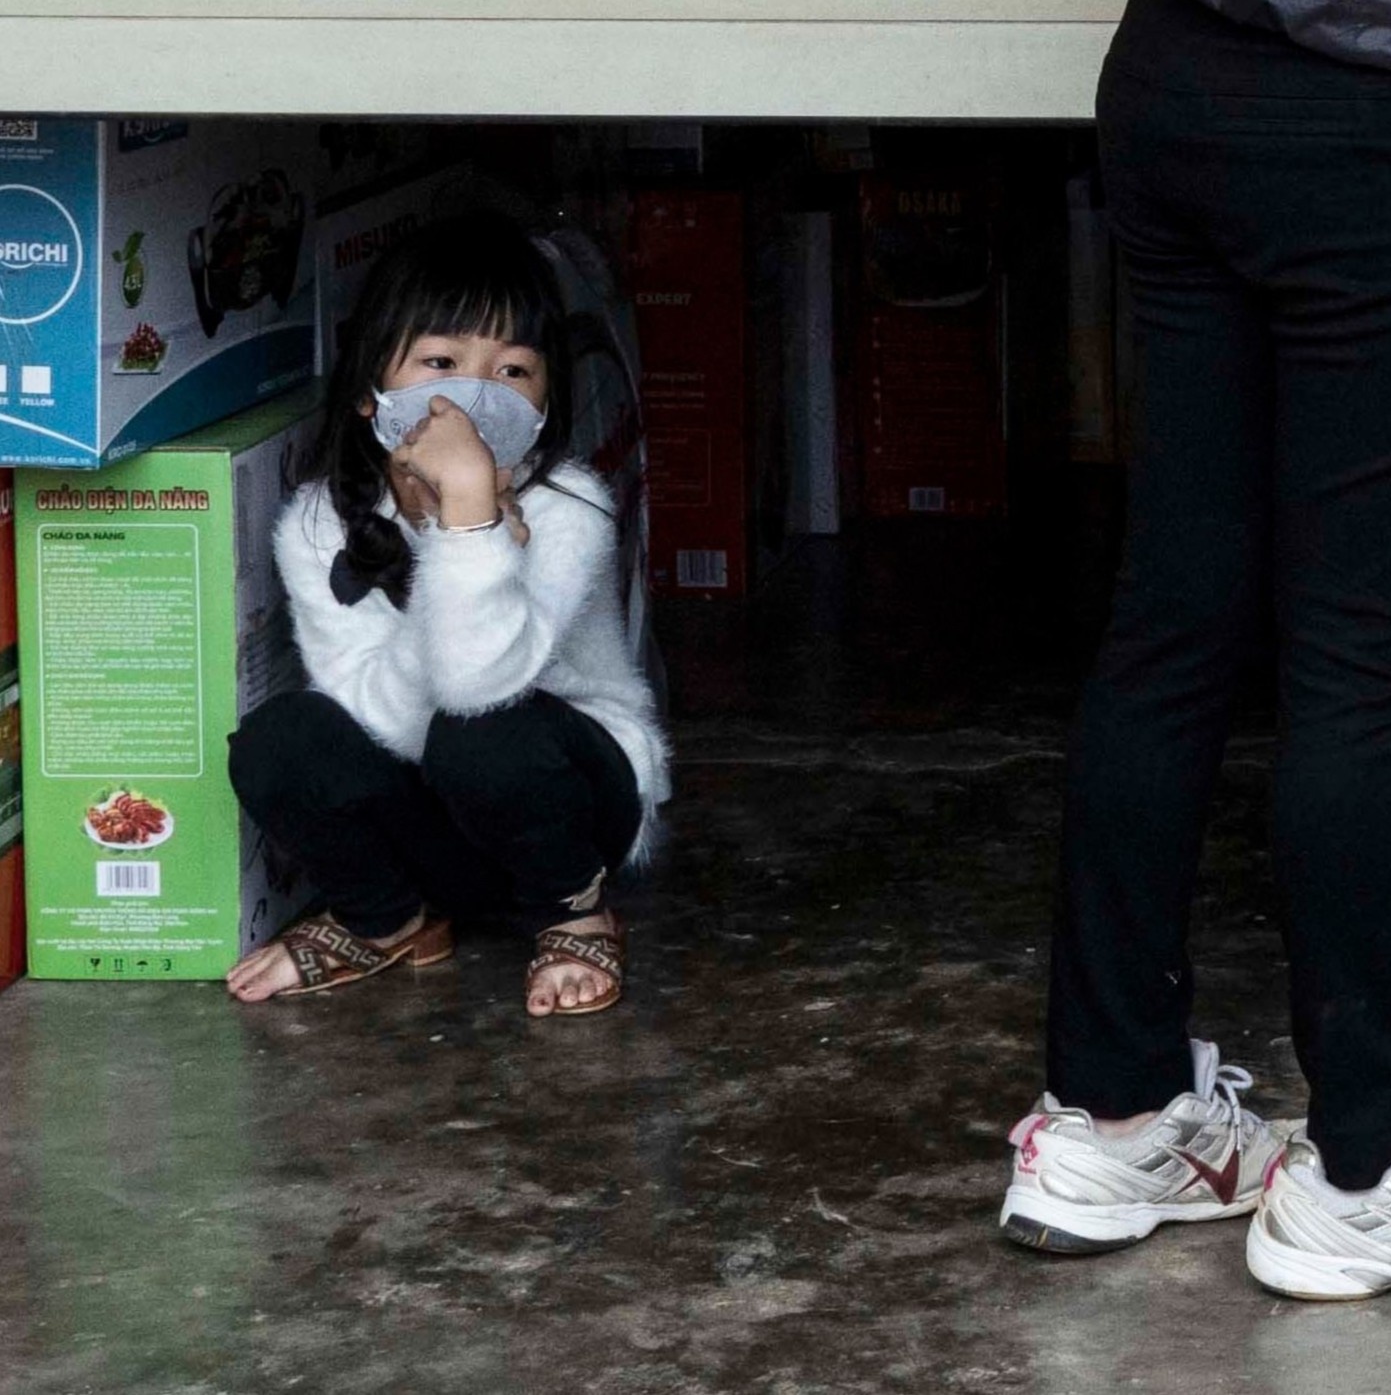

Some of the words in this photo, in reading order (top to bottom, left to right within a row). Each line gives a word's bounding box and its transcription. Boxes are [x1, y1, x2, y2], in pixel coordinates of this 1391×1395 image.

[20, 397, 55, 406] YELLOW
[36, 484, 82, 510] CHẢO
[131, 489, 156, 510] ĐA
[159, 487, 209, 510] NĂNG
